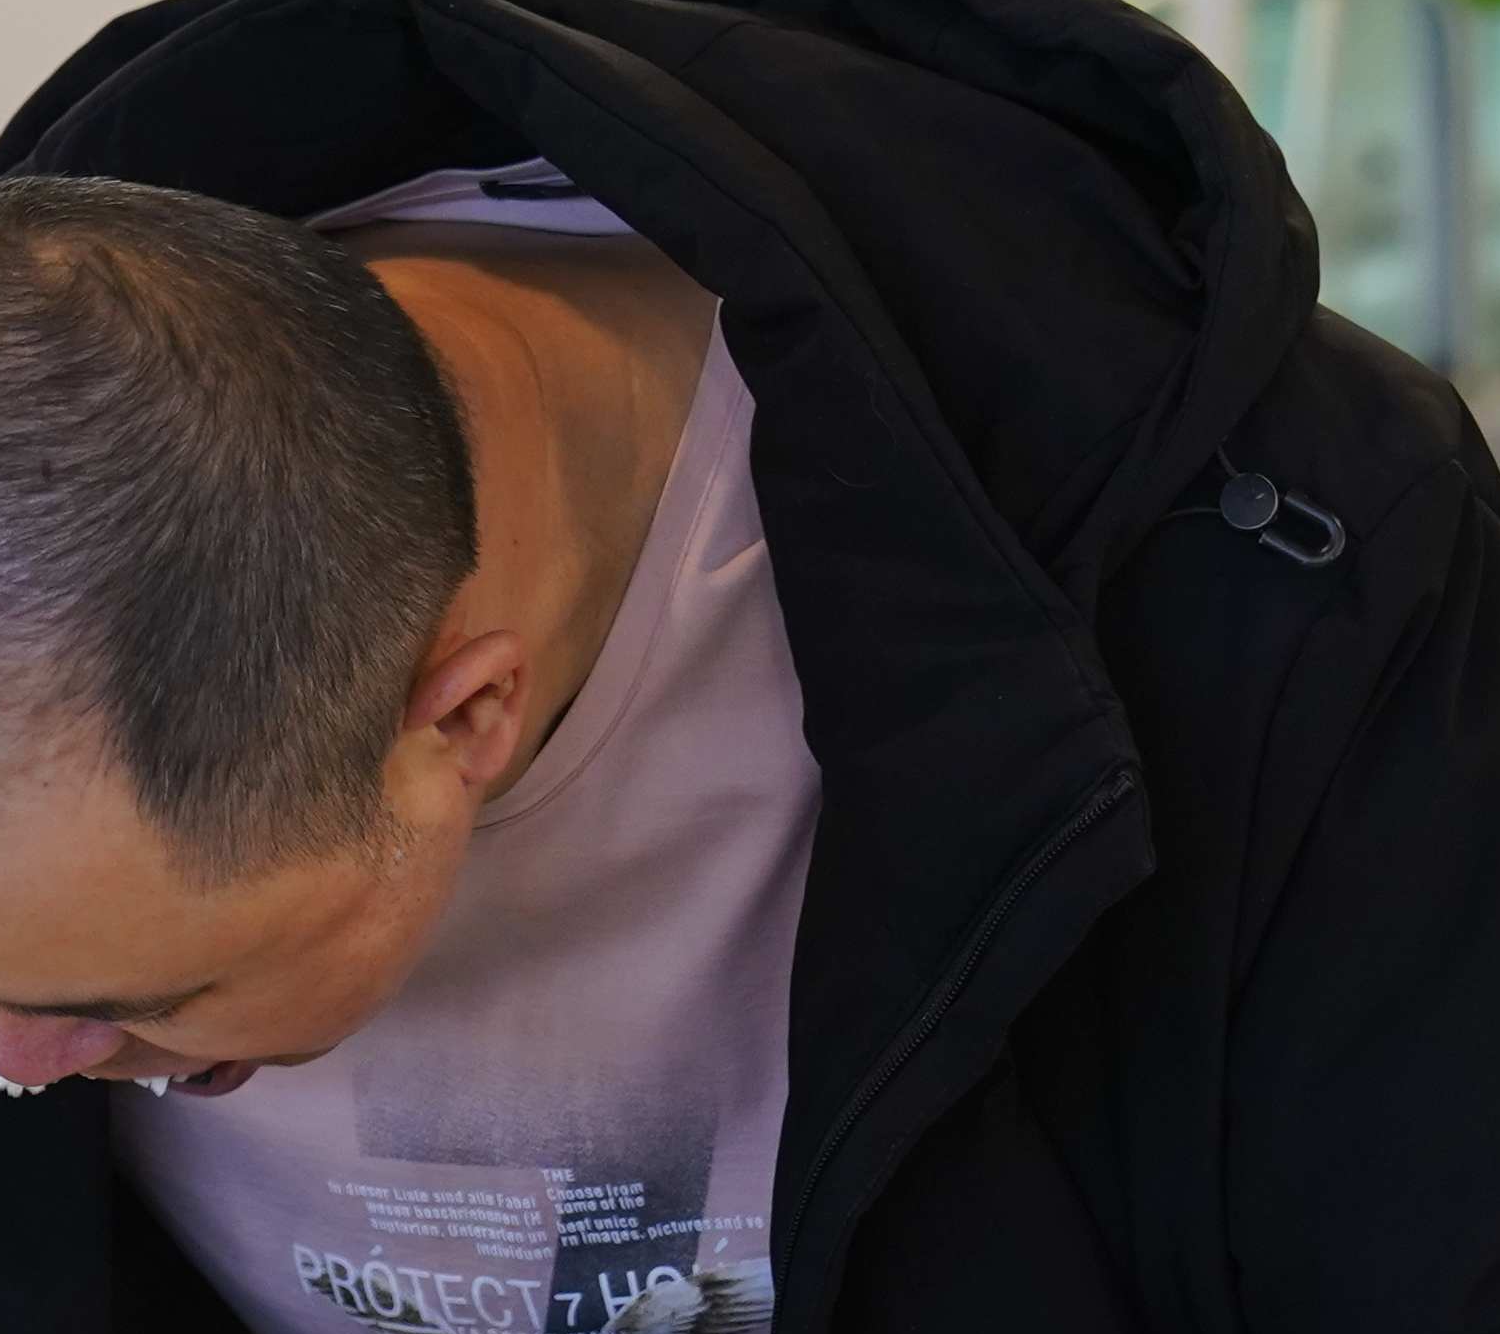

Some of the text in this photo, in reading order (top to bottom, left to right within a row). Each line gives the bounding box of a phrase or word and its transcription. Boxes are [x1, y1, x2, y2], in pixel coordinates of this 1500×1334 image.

[542, 1168, 576, 1183] THE
[433, 1190, 464, 1205] sind
[546, 1182, 644, 1201] Choose from
[554, 1194, 645, 1215] some of the
[647, 1217, 711, 1240] pictures
[714, 1215, 742, 1230] and
